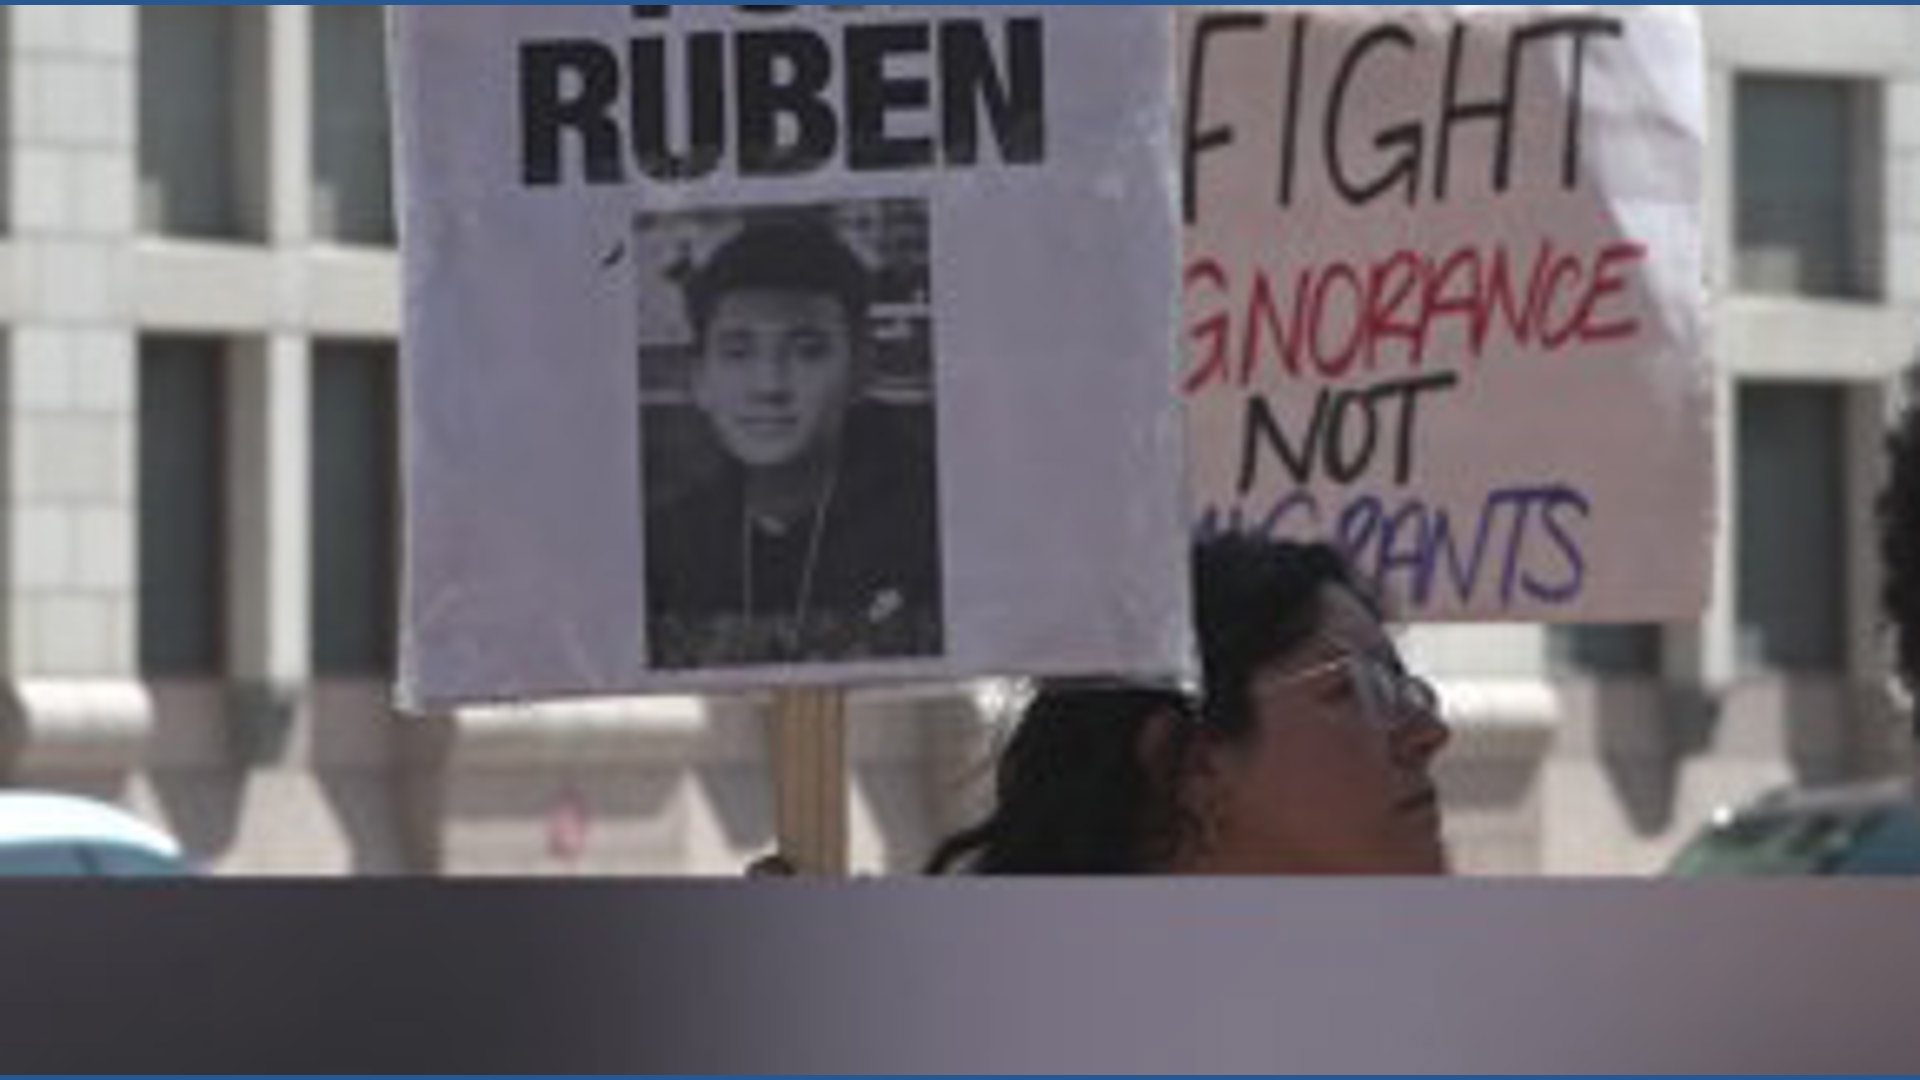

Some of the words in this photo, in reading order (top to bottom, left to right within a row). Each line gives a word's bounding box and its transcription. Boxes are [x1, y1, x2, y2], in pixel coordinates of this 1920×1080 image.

[517, 18, 1045, 187] RUBEN
[1182, 13, 1624, 224] FIGHT
[1237, 371, 1458, 494] NOT
